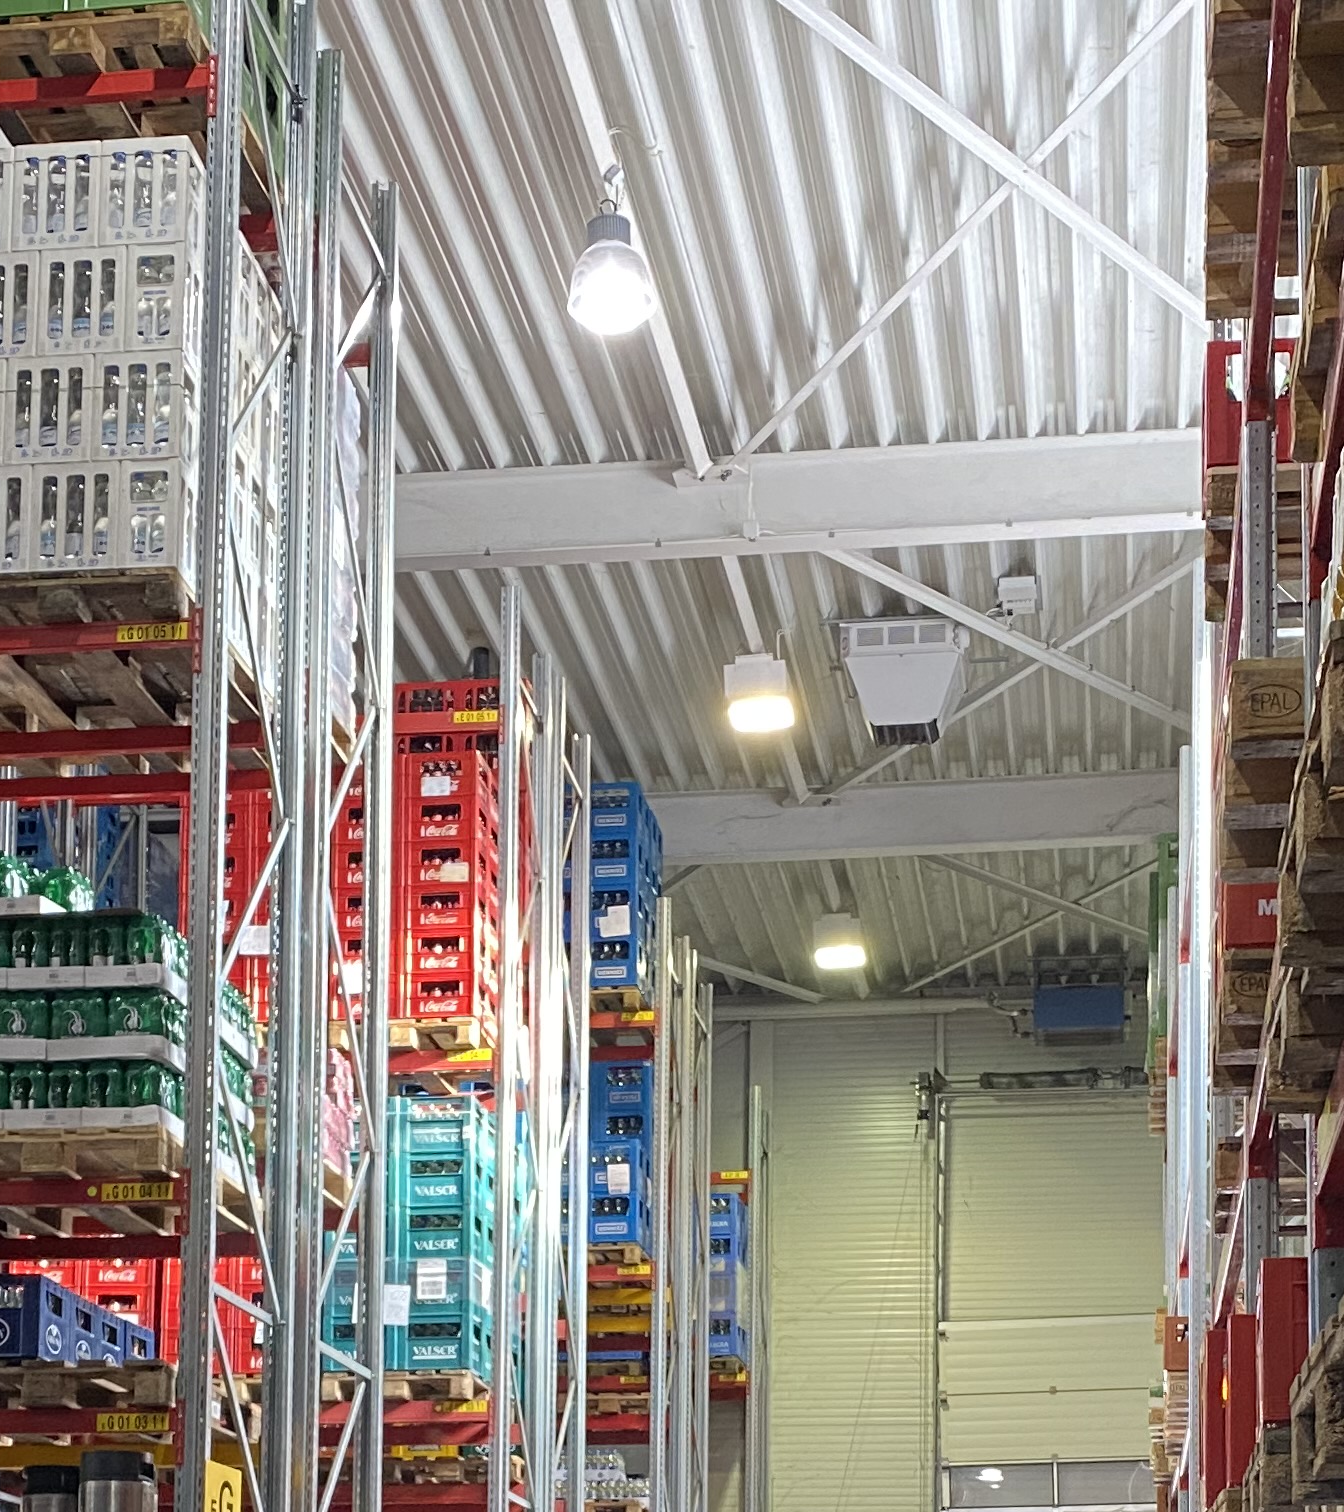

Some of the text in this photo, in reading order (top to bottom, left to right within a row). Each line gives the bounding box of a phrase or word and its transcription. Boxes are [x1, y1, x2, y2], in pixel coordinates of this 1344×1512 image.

[1251, 693, 1292, 713] EPAL
[1240, 975, 1268, 992] EPA
[414, 1239, 457, 1250] VALSER
